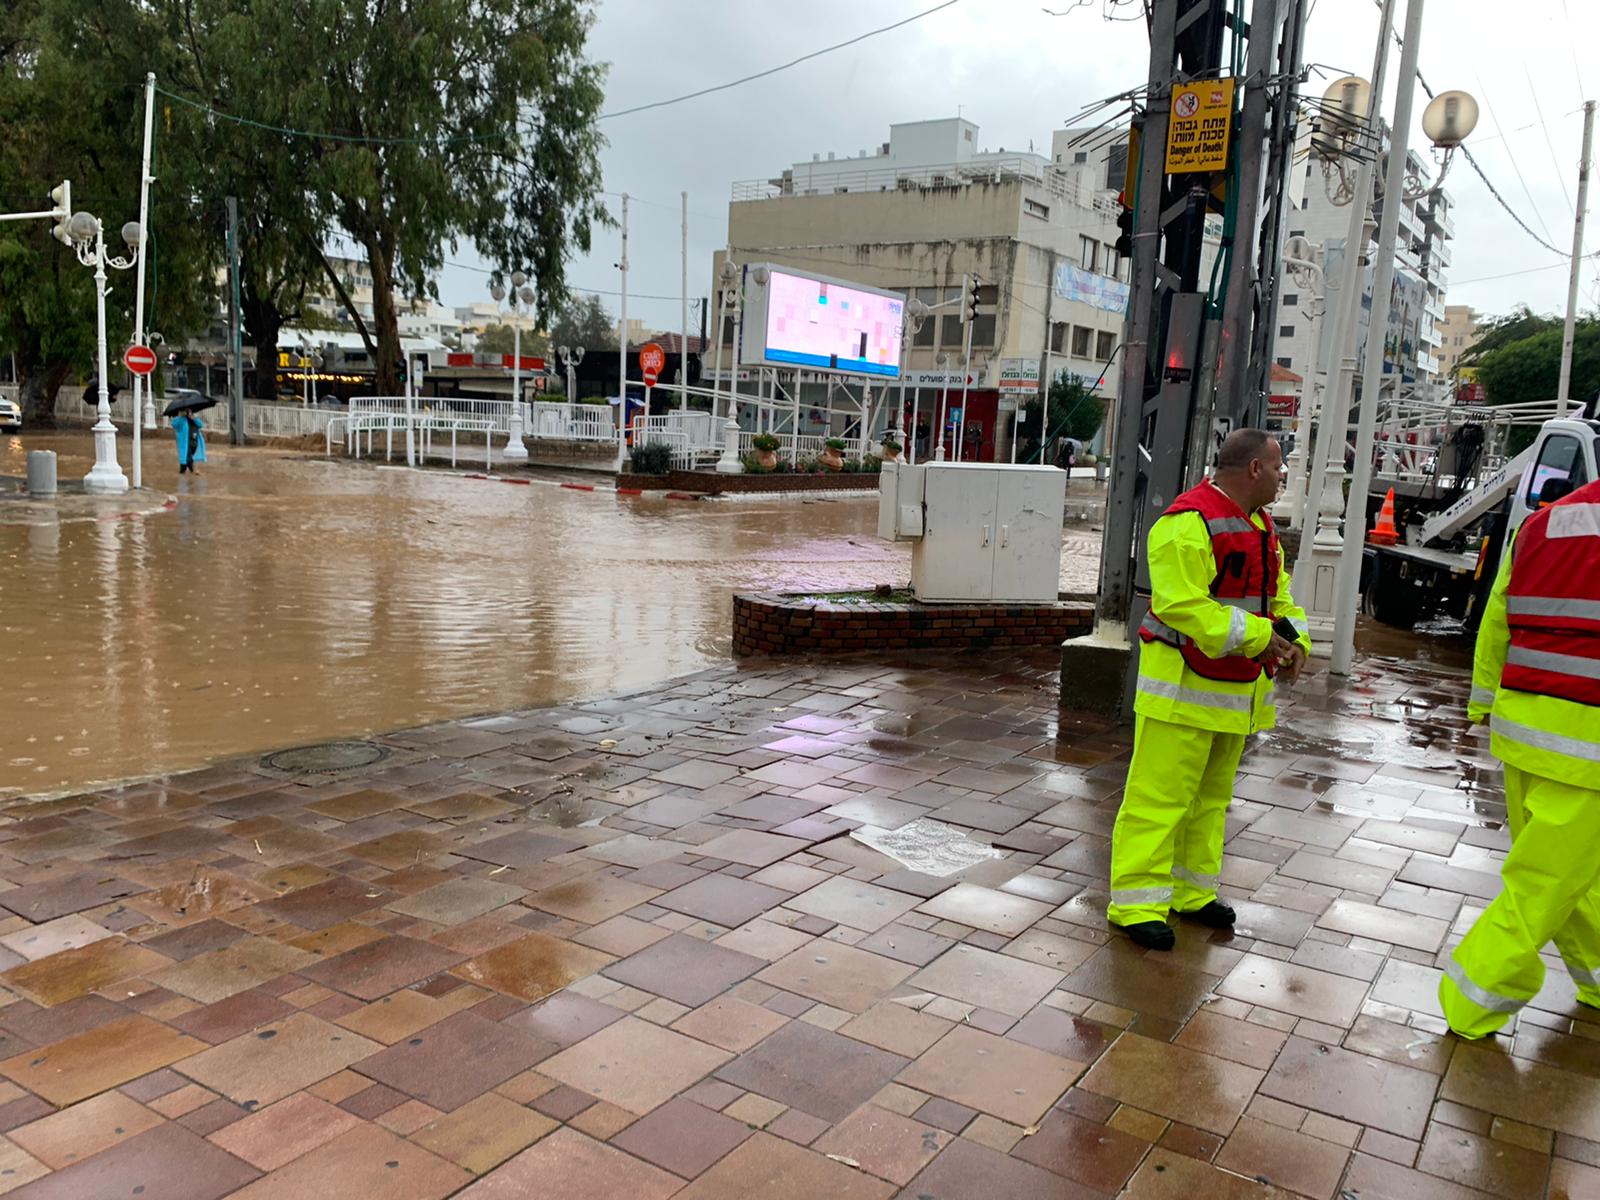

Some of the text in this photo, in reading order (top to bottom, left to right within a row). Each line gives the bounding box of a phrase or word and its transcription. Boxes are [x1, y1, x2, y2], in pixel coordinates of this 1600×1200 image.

[1203, 117, 1226, 130] מתח
[1198, 129, 1225, 141] סכנת
[1170, 145, 1193, 157] Danger
[1194, 142, 1202, 153] of
